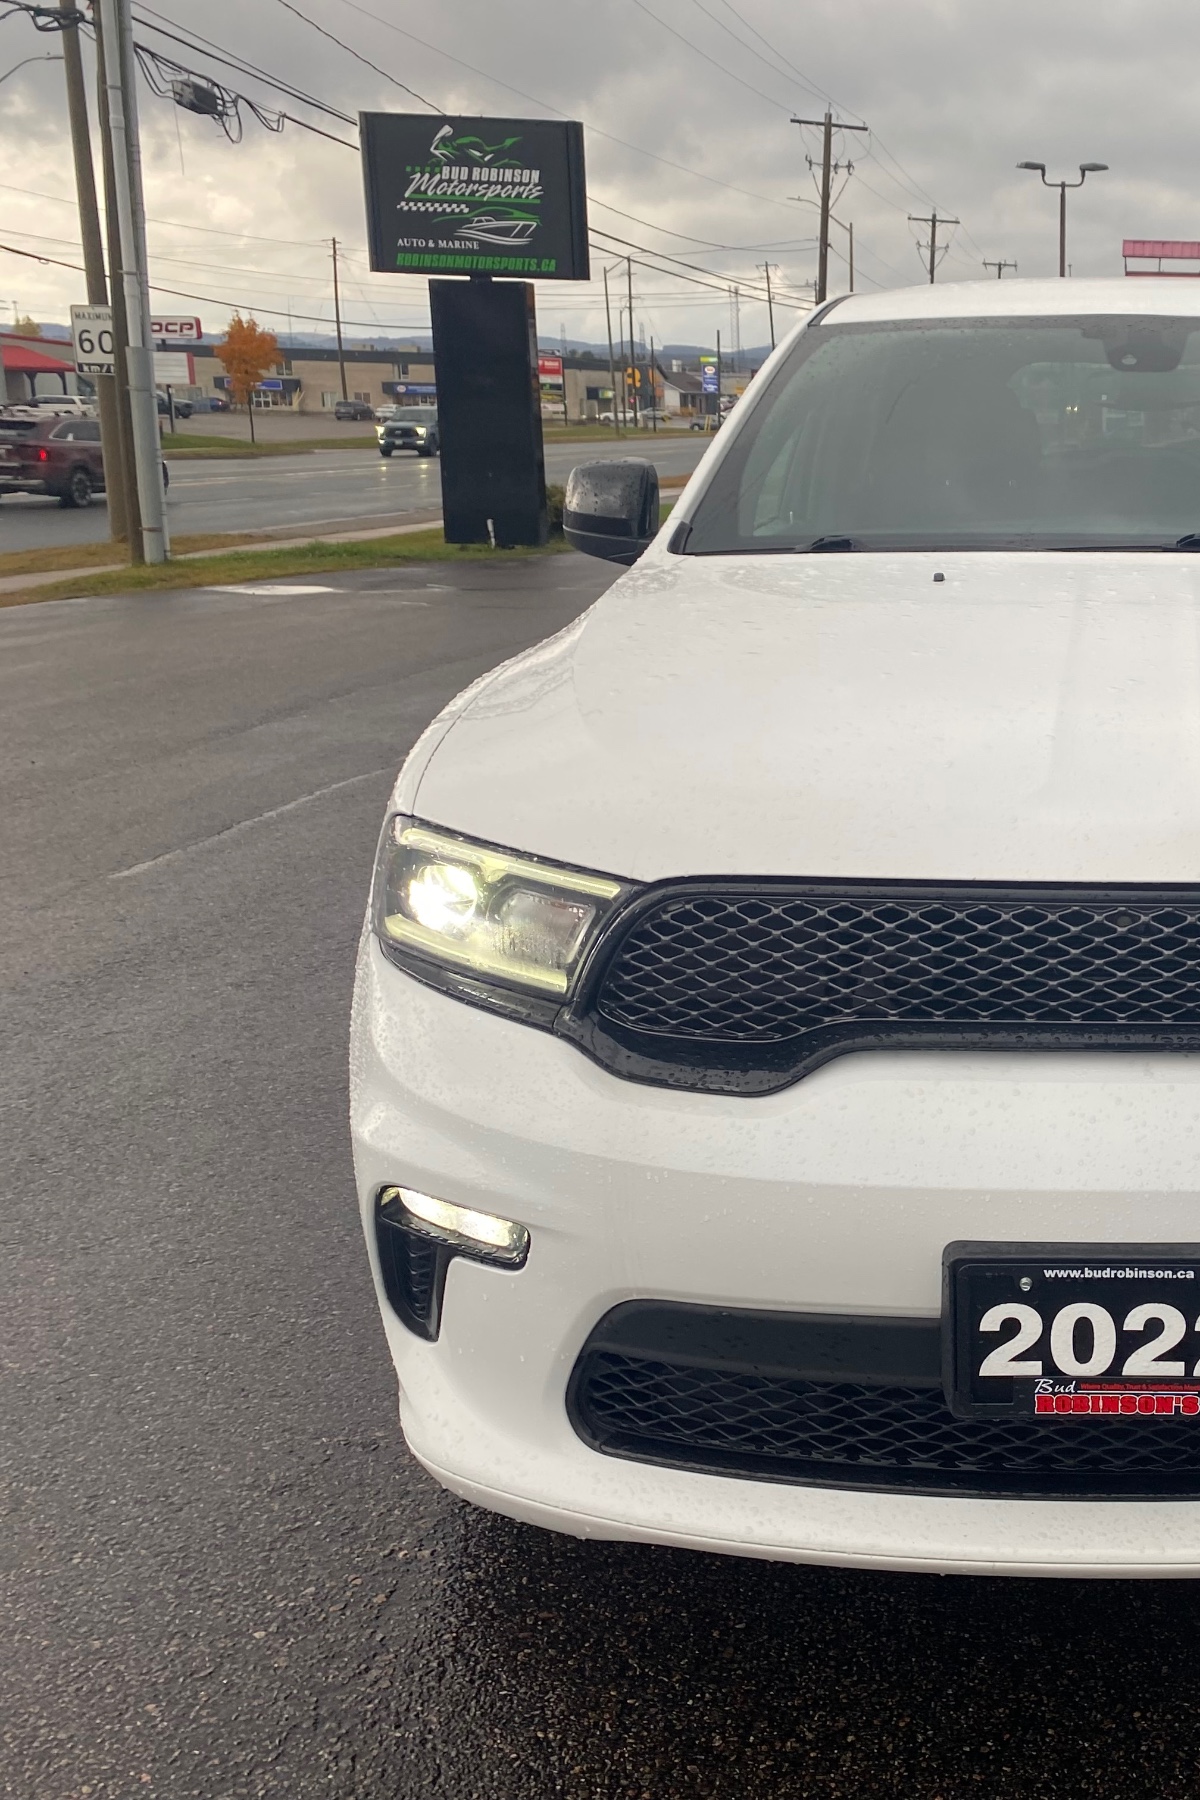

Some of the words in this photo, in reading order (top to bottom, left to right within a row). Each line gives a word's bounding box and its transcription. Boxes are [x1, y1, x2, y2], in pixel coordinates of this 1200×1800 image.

[442, 165, 469, 181] BUD
[472, 166, 541, 184] ROBINSON
[404, 172, 544, 201] Motorsports
[397, 238, 426, 248] AUTO
[428, 240, 435, 248] &
[438, 240, 480, 250] MARINE
[396, 252, 557, 272] ROBINSONMOTORSPORTS.CA
[79, 329, 114, 354] 60
[1043, 1267, 1195, 1279] www.budrobinson.ca
[1034, 1378, 1076, 1394] Bud
[1034, 1394, 1200, 1416] ROBINSON'S
